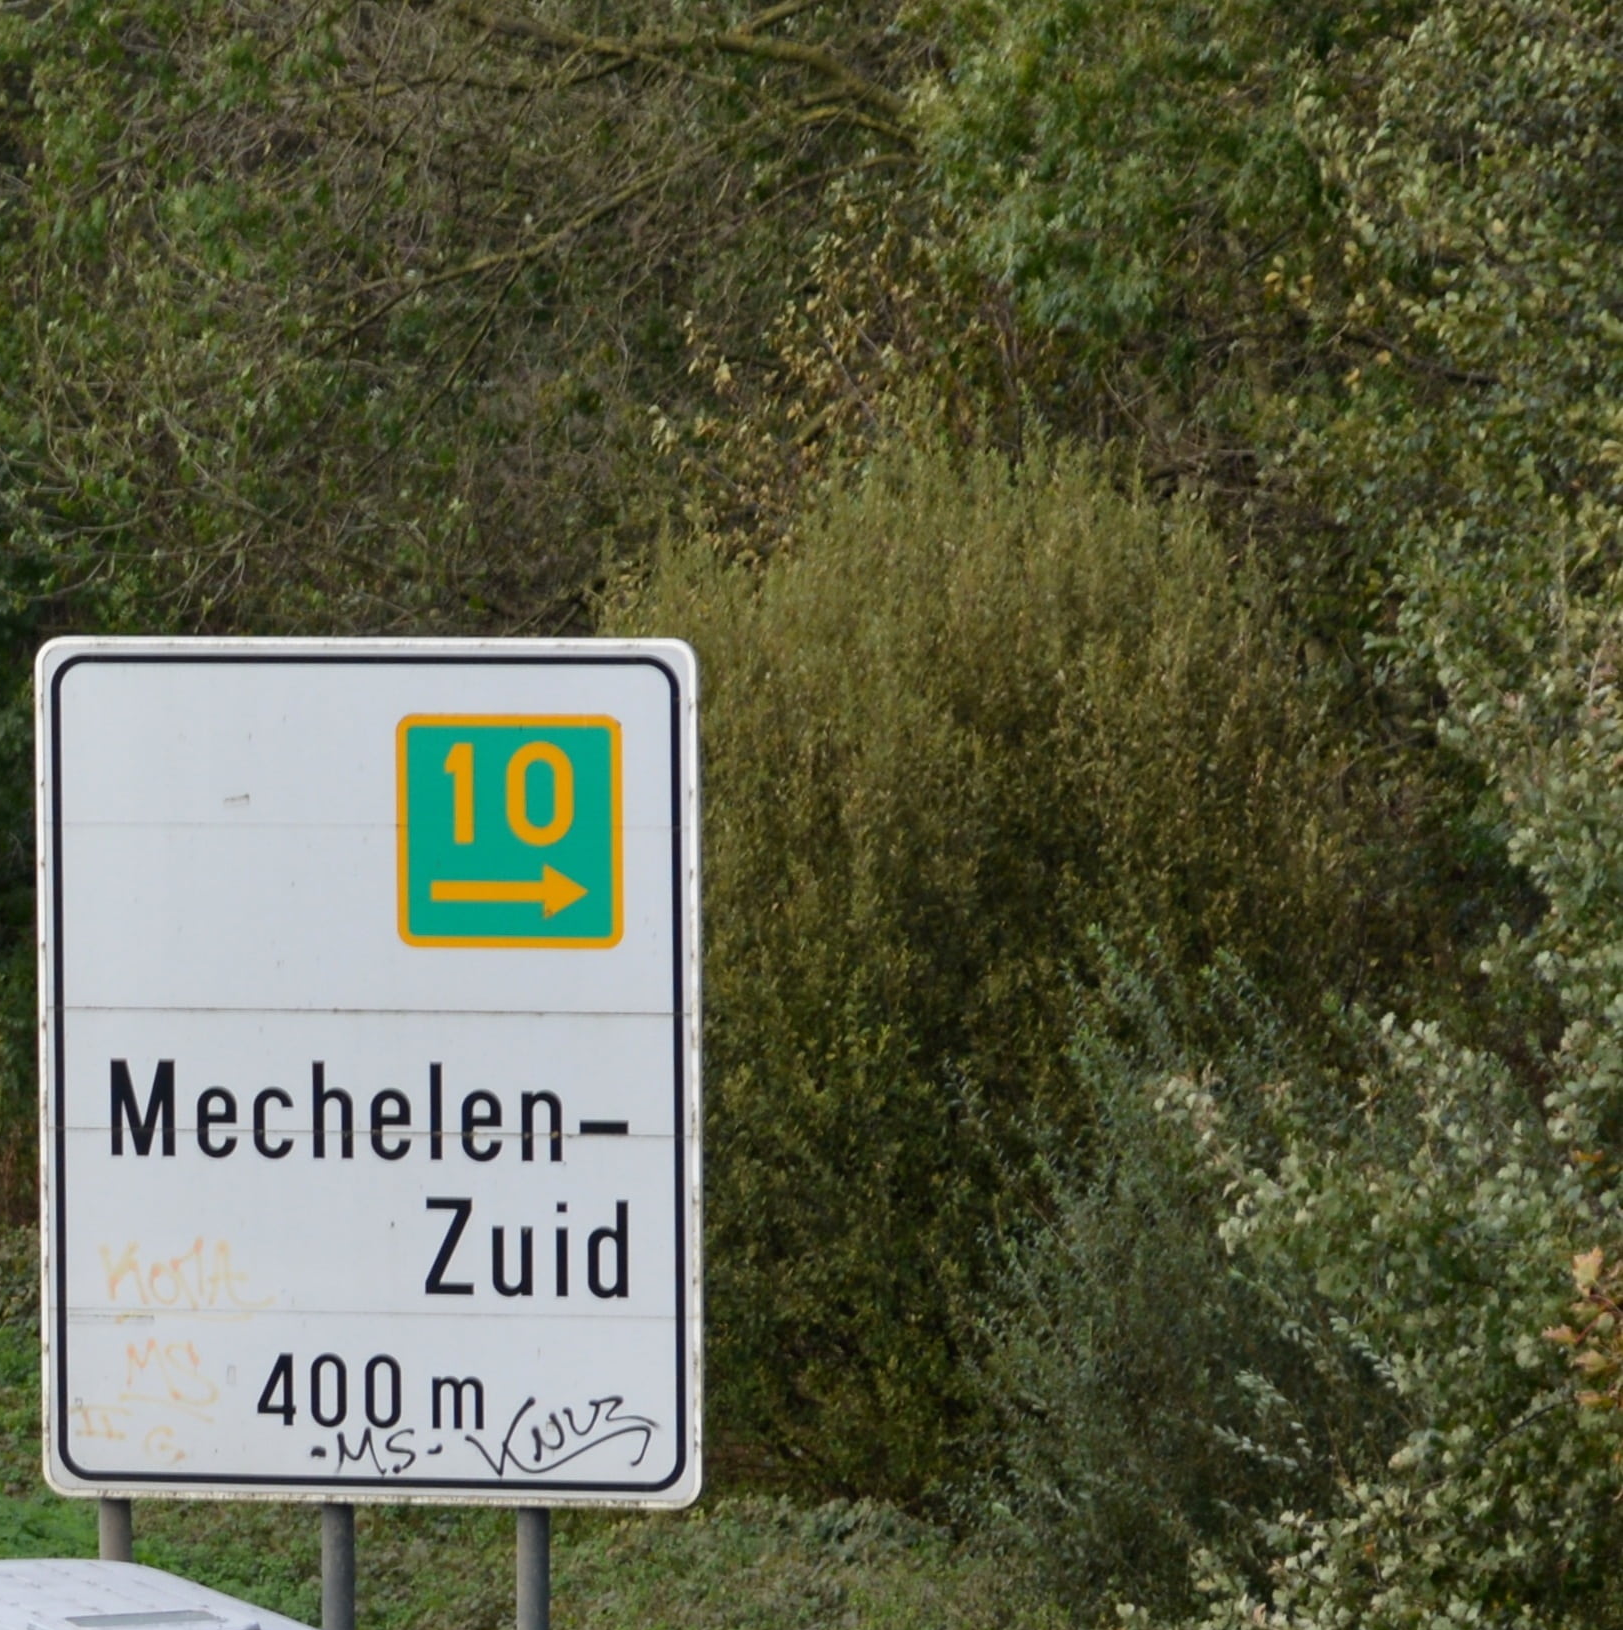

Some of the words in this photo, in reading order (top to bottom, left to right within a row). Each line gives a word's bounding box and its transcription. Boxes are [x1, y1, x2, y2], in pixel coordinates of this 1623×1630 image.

[444, 741, 574, 846] 10
[109, 1058, 629, 1162] Mechelen-
[425, 1196, 629, 1299] Zuid
[257, 1353, 402, 1430] 400
[431, 1376, 485, 1430] m
